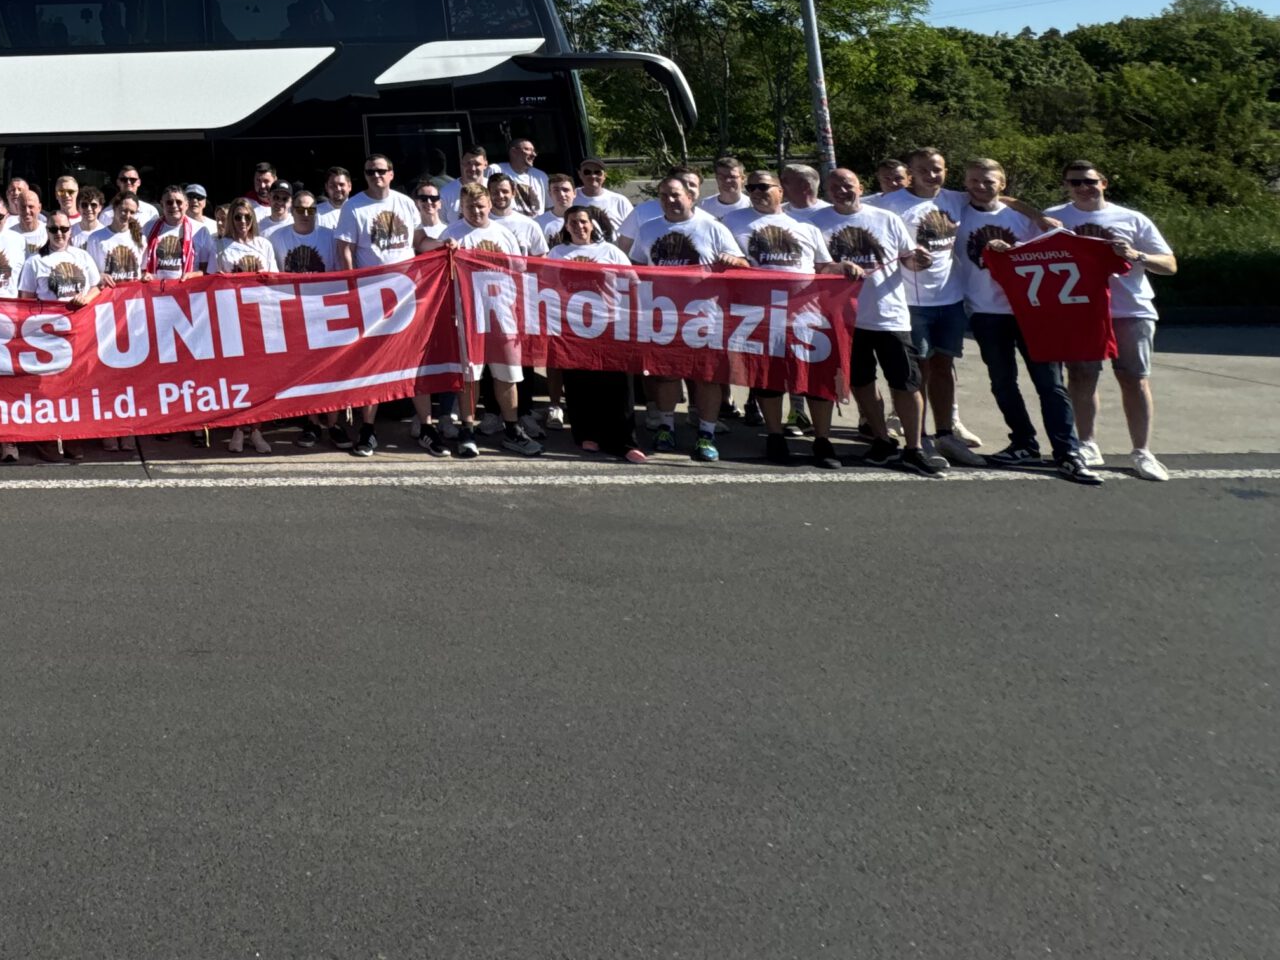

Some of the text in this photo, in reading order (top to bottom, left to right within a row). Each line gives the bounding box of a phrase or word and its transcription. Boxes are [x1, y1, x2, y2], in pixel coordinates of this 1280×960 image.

[471, 271, 833, 363] Rhoibazis
[1014, 262, 1090, 306] 72
[94, 272, 418, 369] UNITED
[91, 385, 148, 421] i.d.
[158, 378, 251, 415] Pfalz
